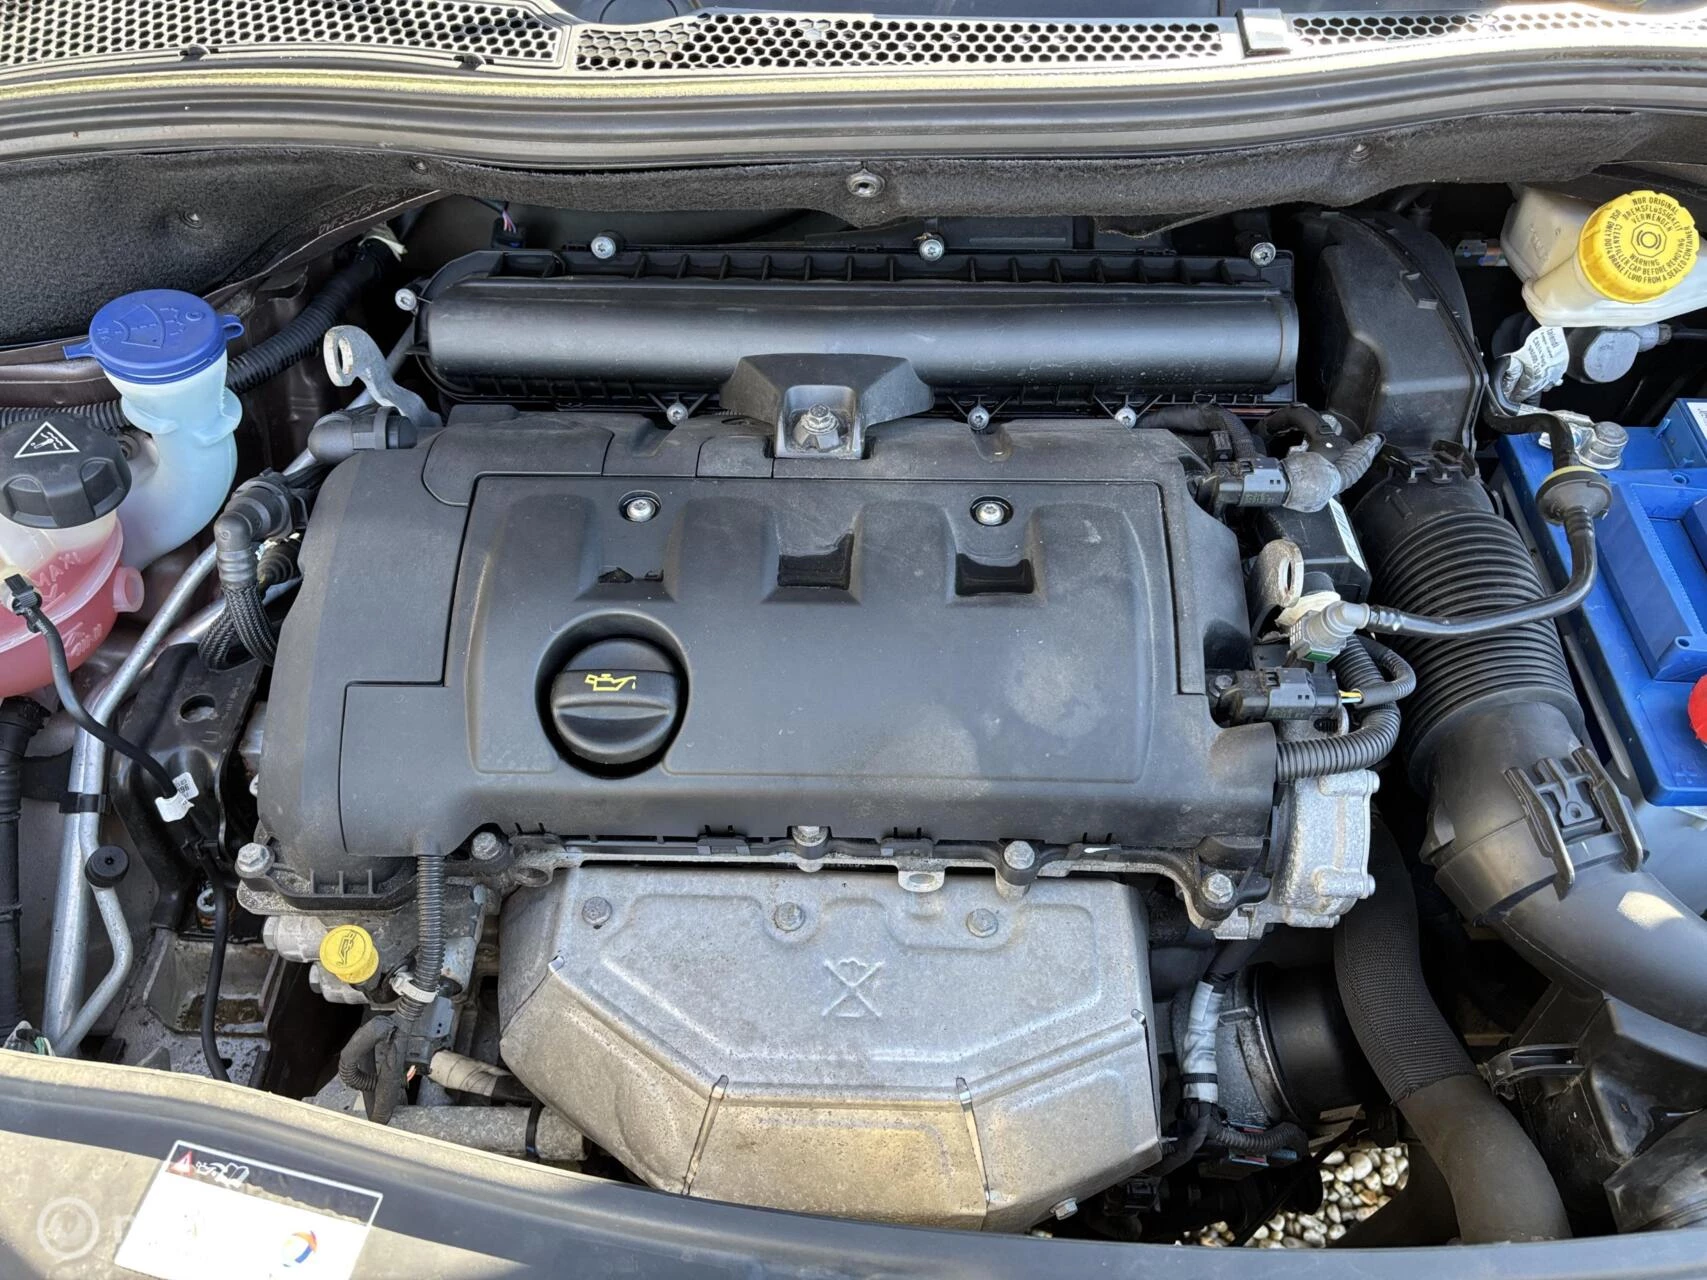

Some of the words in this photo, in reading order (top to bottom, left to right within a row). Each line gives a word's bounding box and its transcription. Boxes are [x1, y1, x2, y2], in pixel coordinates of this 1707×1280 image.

[1609, 209, 1621, 221] USE
[1632, 197, 1646, 206] NUR
[1649, 197, 1679, 215] ORIGINAL
[1604, 221, 1615, 237] ONLY
[1631, 213, 1673, 232] VERWENDEN
[1682, 225, 1693, 261] CONTAINER
[1608, 254, 1625, 274] BRAKE
[1629, 263, 1642, 275] CAP
[1642, 265, 1668, 276] BEFORE
[1666, 238, 1685, 268] REMOVING
[1629, 253, 1660, 267] WARNING
[1623, 269, 1643, 283] FLUID
[1667, 259, 1687, 280] SEALED
[1643, 276, 1662, 284] FROM
